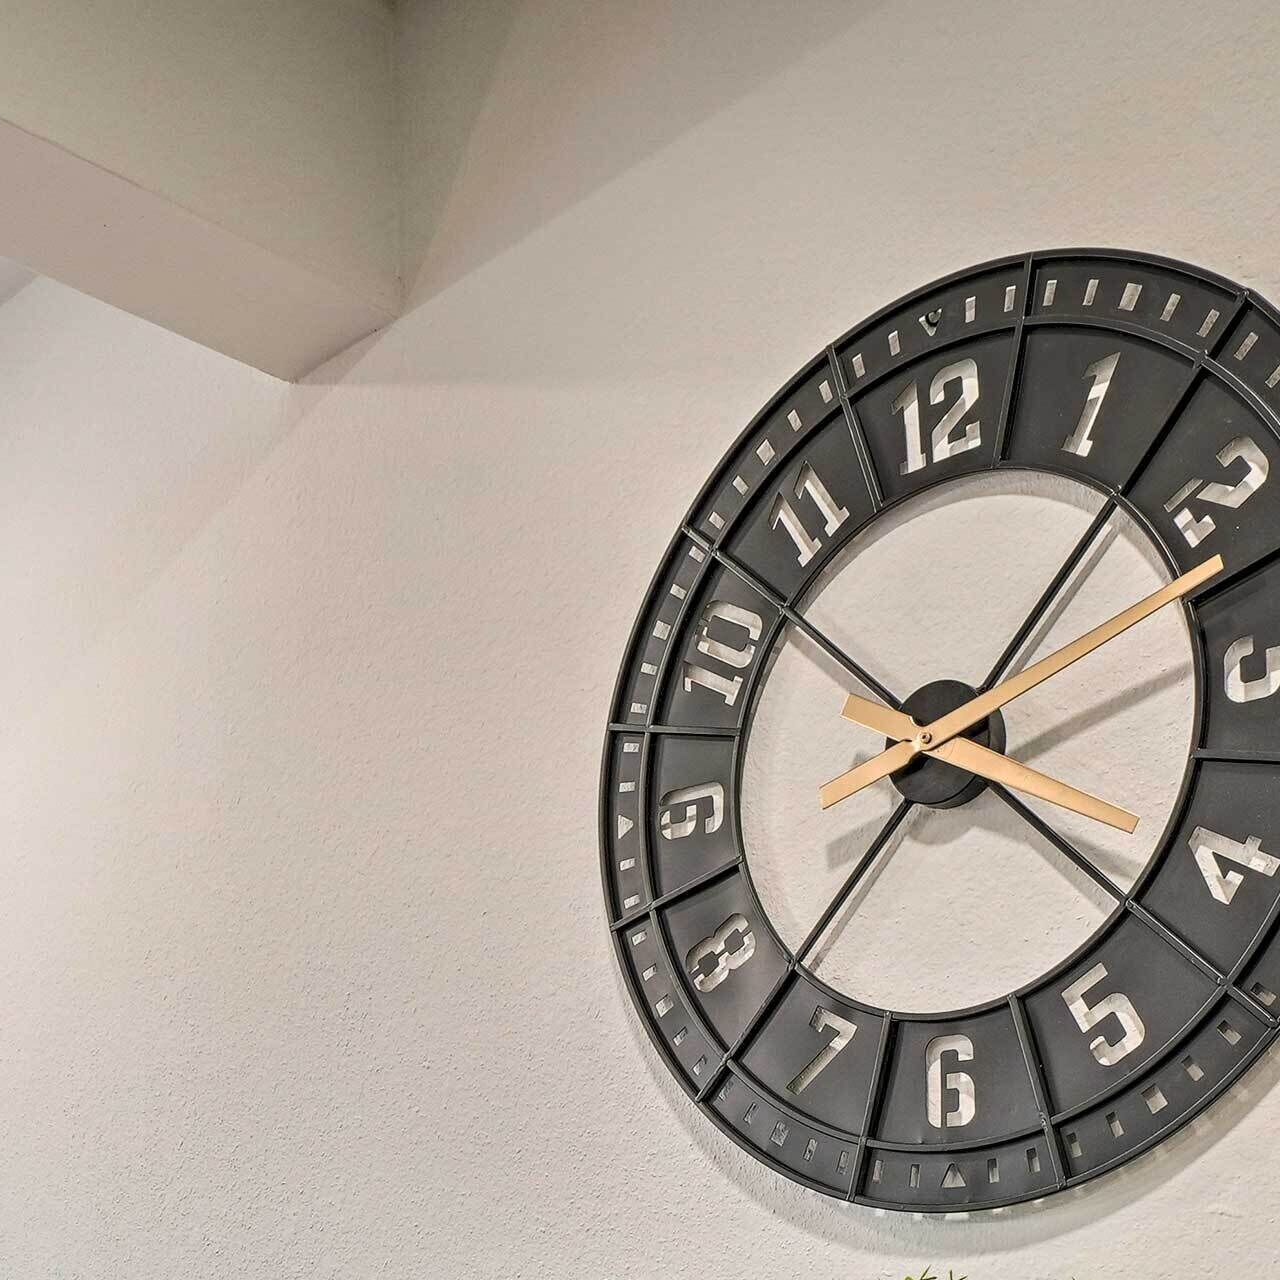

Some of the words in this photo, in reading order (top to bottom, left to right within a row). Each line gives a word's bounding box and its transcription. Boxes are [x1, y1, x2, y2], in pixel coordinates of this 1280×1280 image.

[891, 357, 981, 475] 12
[1062, 351, 1121, 457] 1
[766, 459, 850, 568] 11
[1162, 434, 1271, 549] 2
[681, 599, 765, 708] 10
[659, 780, 725, 842] 9
[684, 912, 756, 993] 8
[787, 1006, 857, 1095] 7
[1060, 963, 1145, 1068] 5
[925, 1033, 976, 1128] 6
